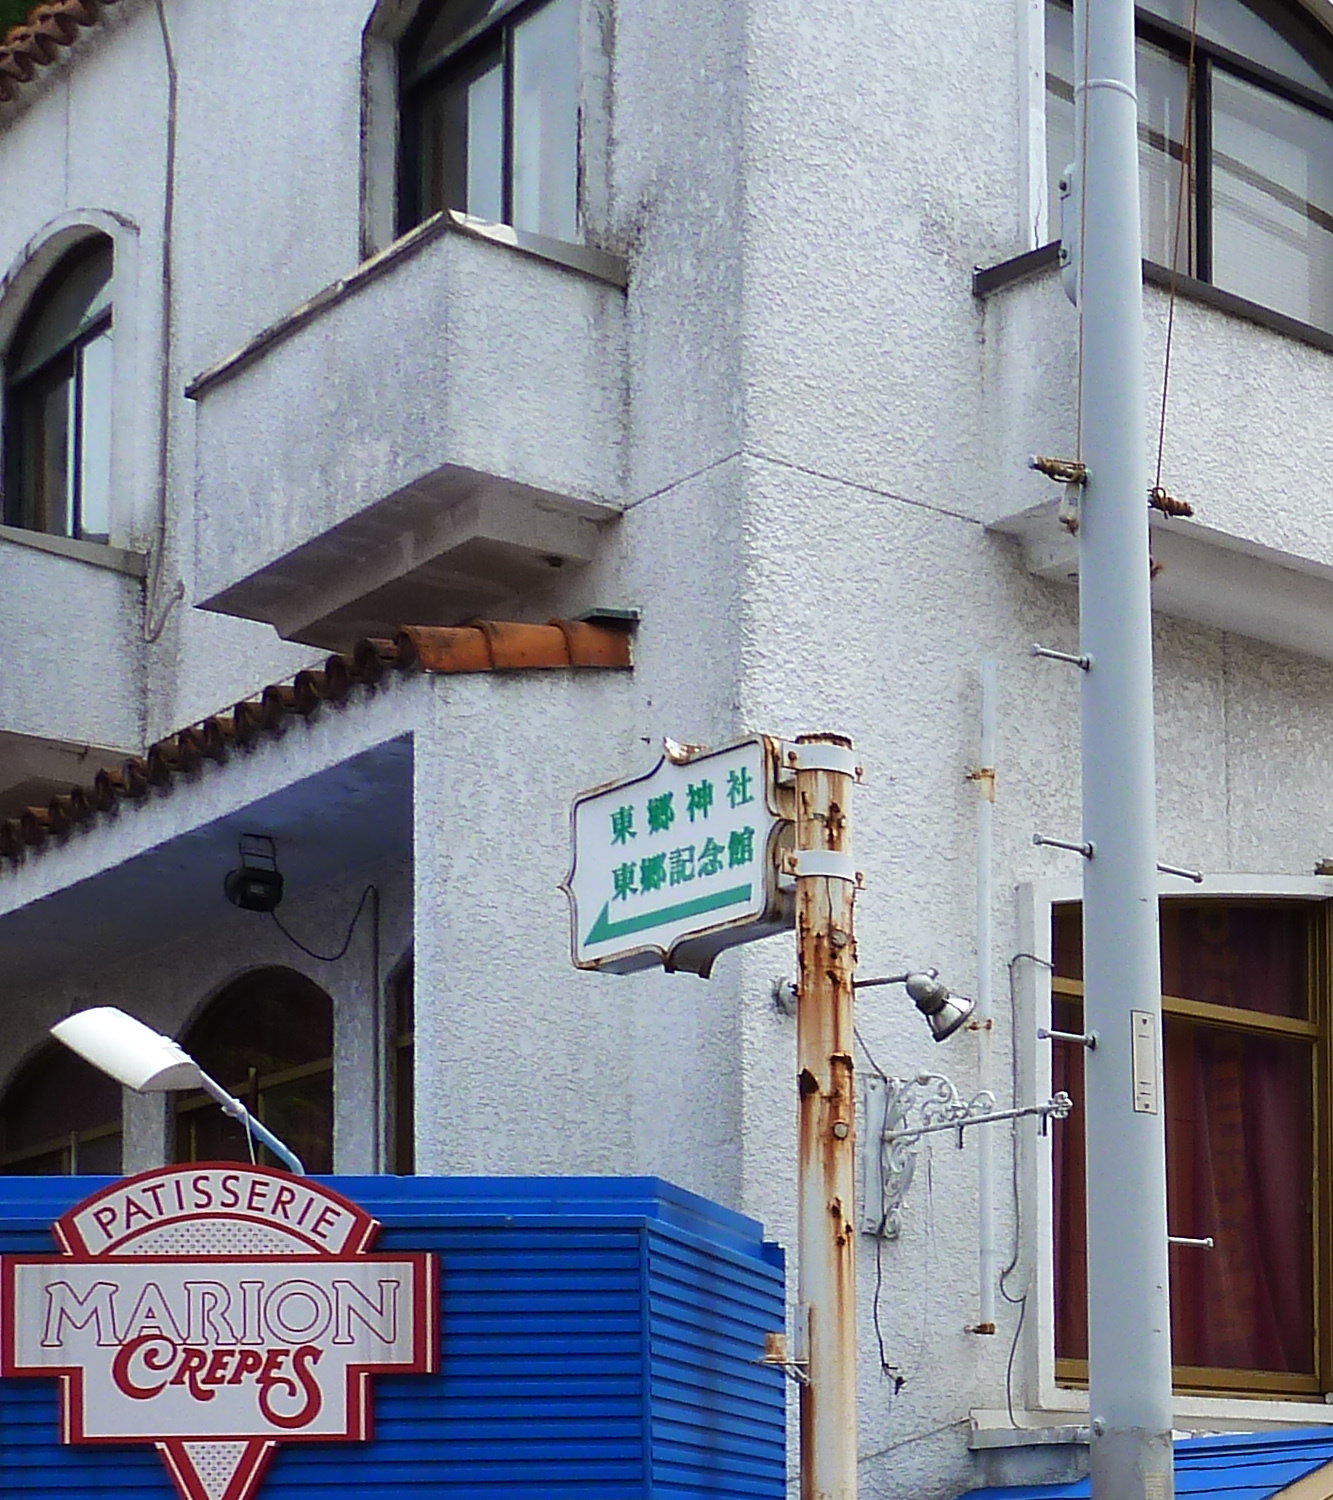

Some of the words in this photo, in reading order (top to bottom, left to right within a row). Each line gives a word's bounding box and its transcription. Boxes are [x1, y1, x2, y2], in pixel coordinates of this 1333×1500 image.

[609, 766, 755, 845] 東郷神社
[611, 826, 756, 902] 東郷記念館
[93, 1174, 341, 1239] PATISSERIE
[41, 1279, 400, 1348] MARION
[112, 1334, 325, 1429] CREPES
